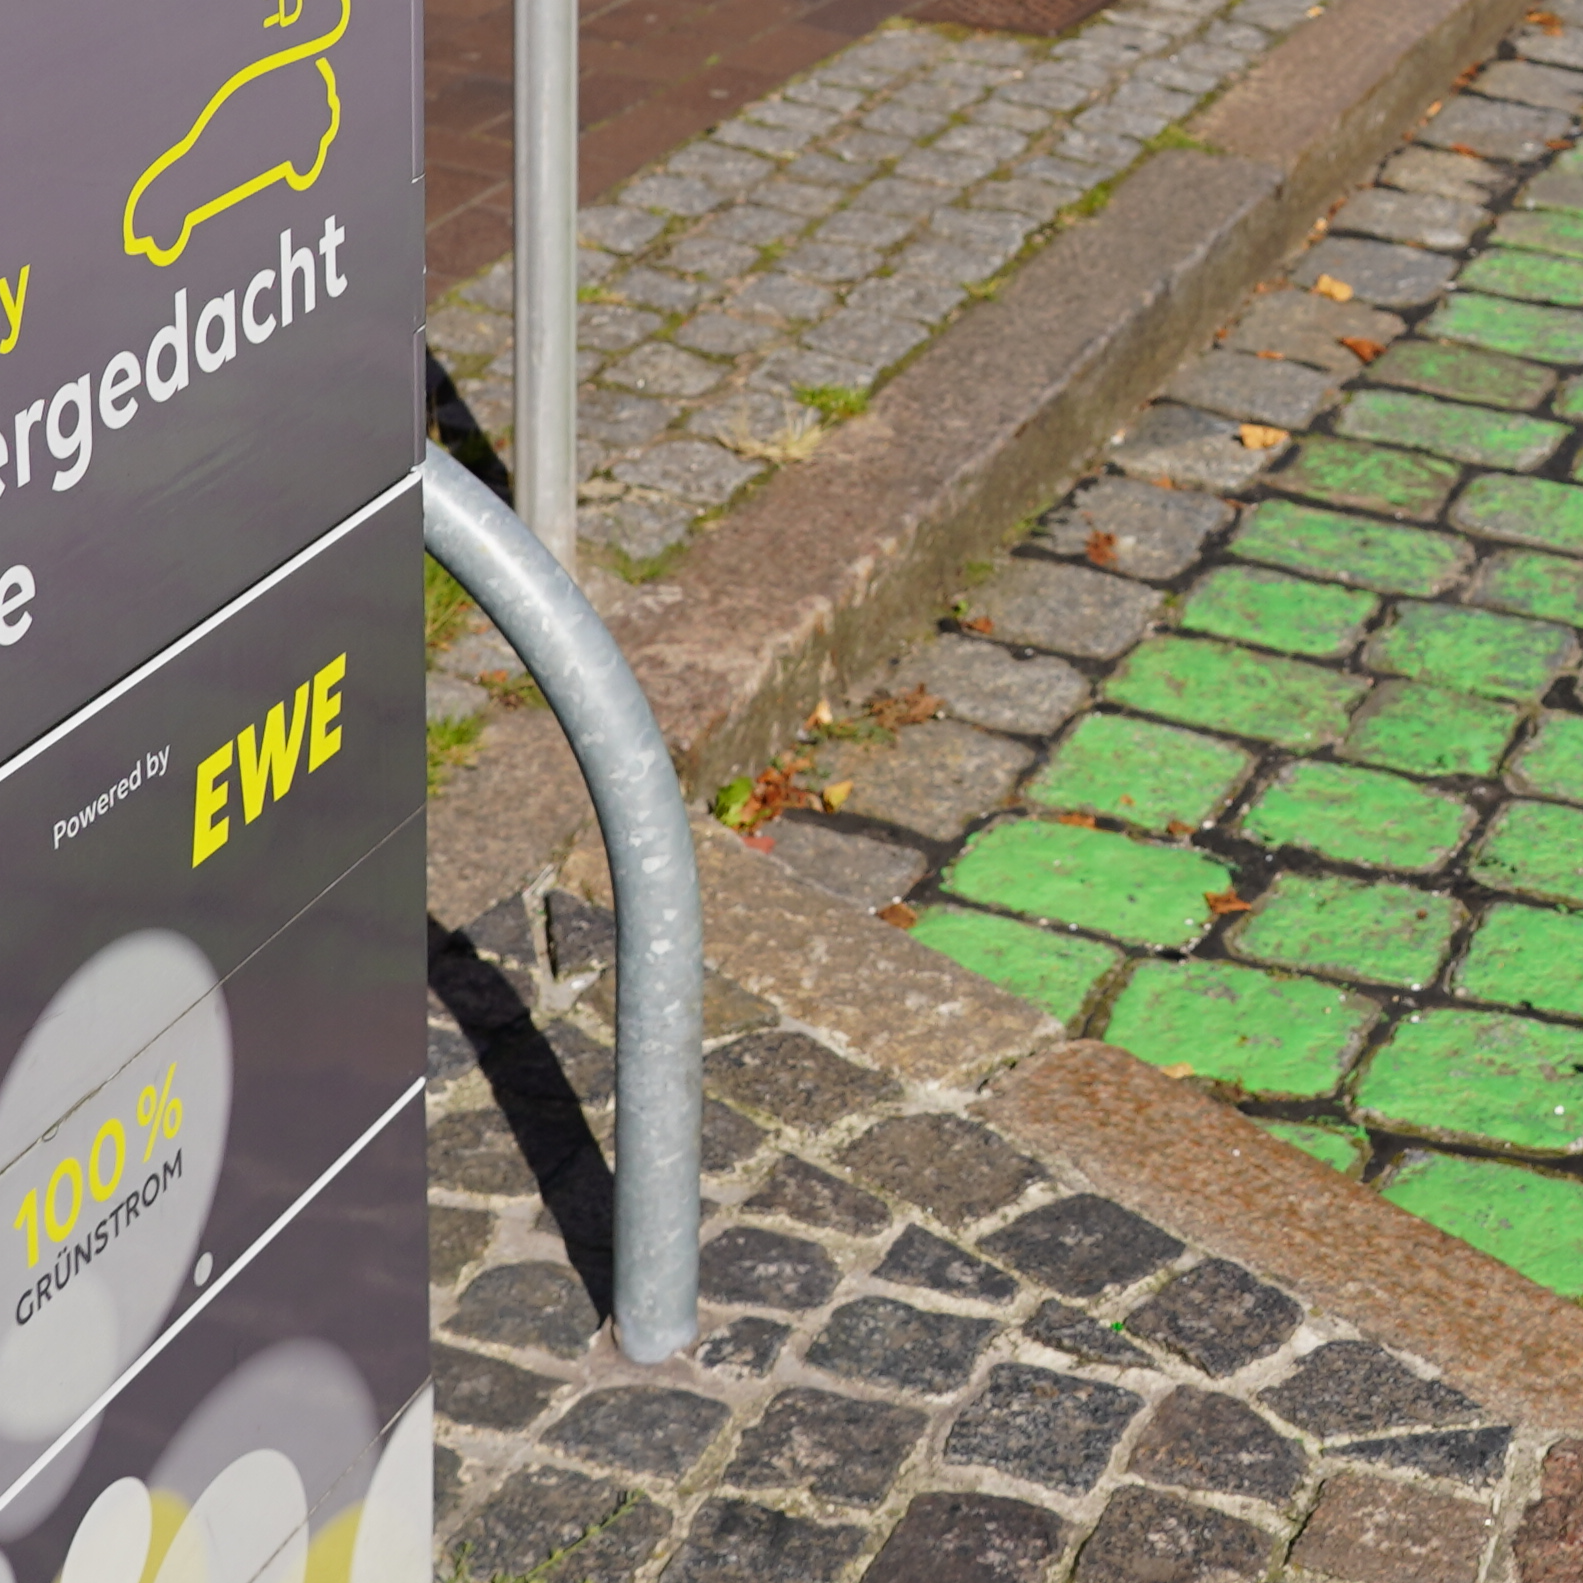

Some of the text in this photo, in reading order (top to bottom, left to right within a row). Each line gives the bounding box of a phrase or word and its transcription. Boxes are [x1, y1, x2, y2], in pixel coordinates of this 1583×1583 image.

[52, 744, 171, 850] Powered by
[191, 652, 347, 869] EWE
[13, 1118, 126, 1269] 100
[16, 1148, 183, 1326] GRÜNSTROM
